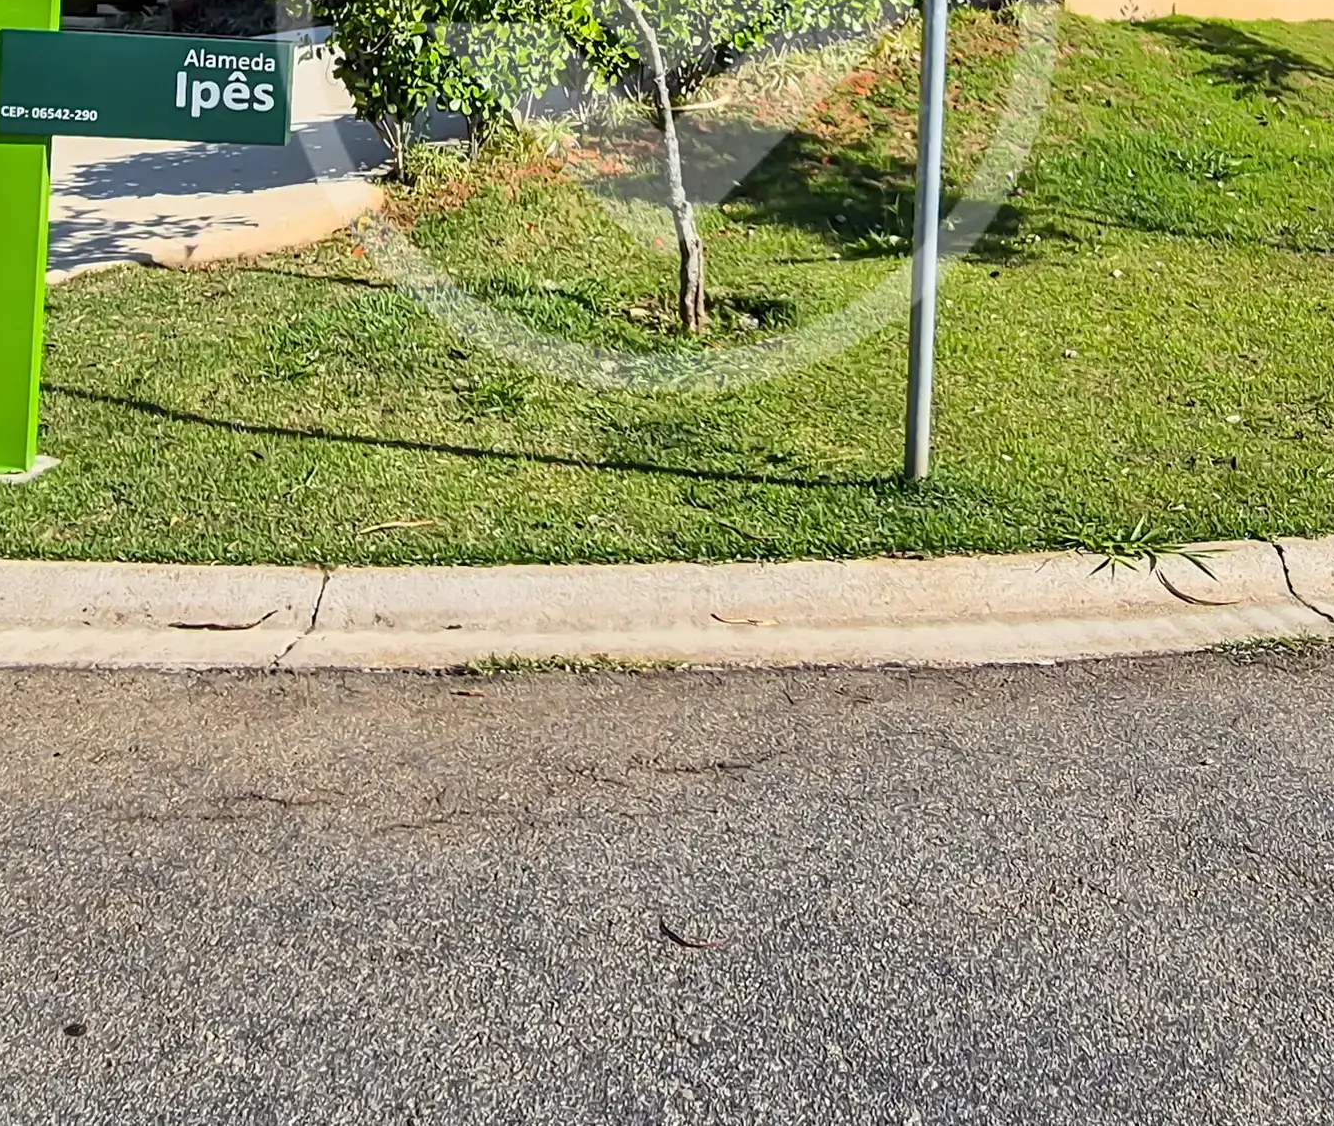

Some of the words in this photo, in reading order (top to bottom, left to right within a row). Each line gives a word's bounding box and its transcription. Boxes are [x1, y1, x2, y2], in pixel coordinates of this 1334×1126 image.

[183, 48, 276, 72] Alameda
[175, 71, 275, 118] Ipês
[0, 105, 29, 118] CEP:
[31, 107, 98, 122] 06542-290
